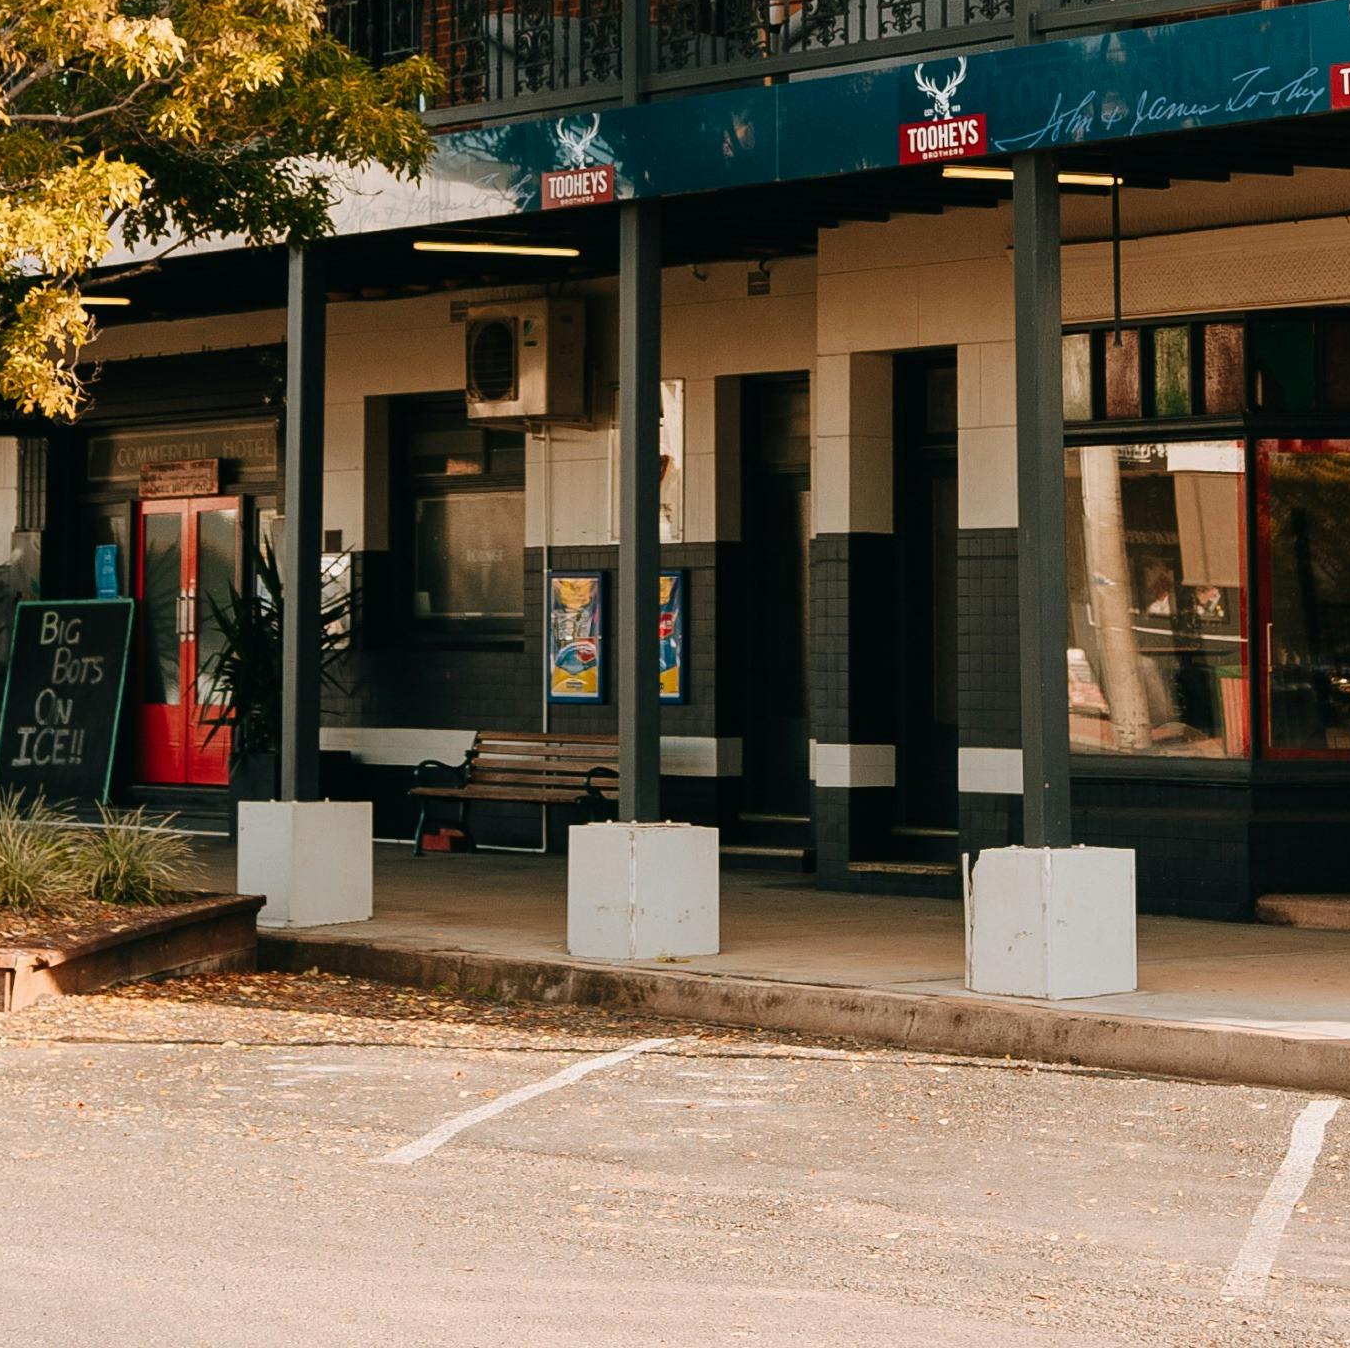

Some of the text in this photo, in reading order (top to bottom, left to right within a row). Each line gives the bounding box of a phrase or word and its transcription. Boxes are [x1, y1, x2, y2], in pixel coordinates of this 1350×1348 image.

[907, 119, 979, 153] TOOHEYS
[922, 148, 965, 160] BROTHERS
[548, 170, 608, 199] TOOHEYS
[116, 436, 272, 468] COMMERCIAL HOTEL
[40, 611, 82, 644] BIG
[52, 647, 105, 684] BOTS
[35, 688, 73, 725] ON
[11, 726, 85, 767] ICE!!
